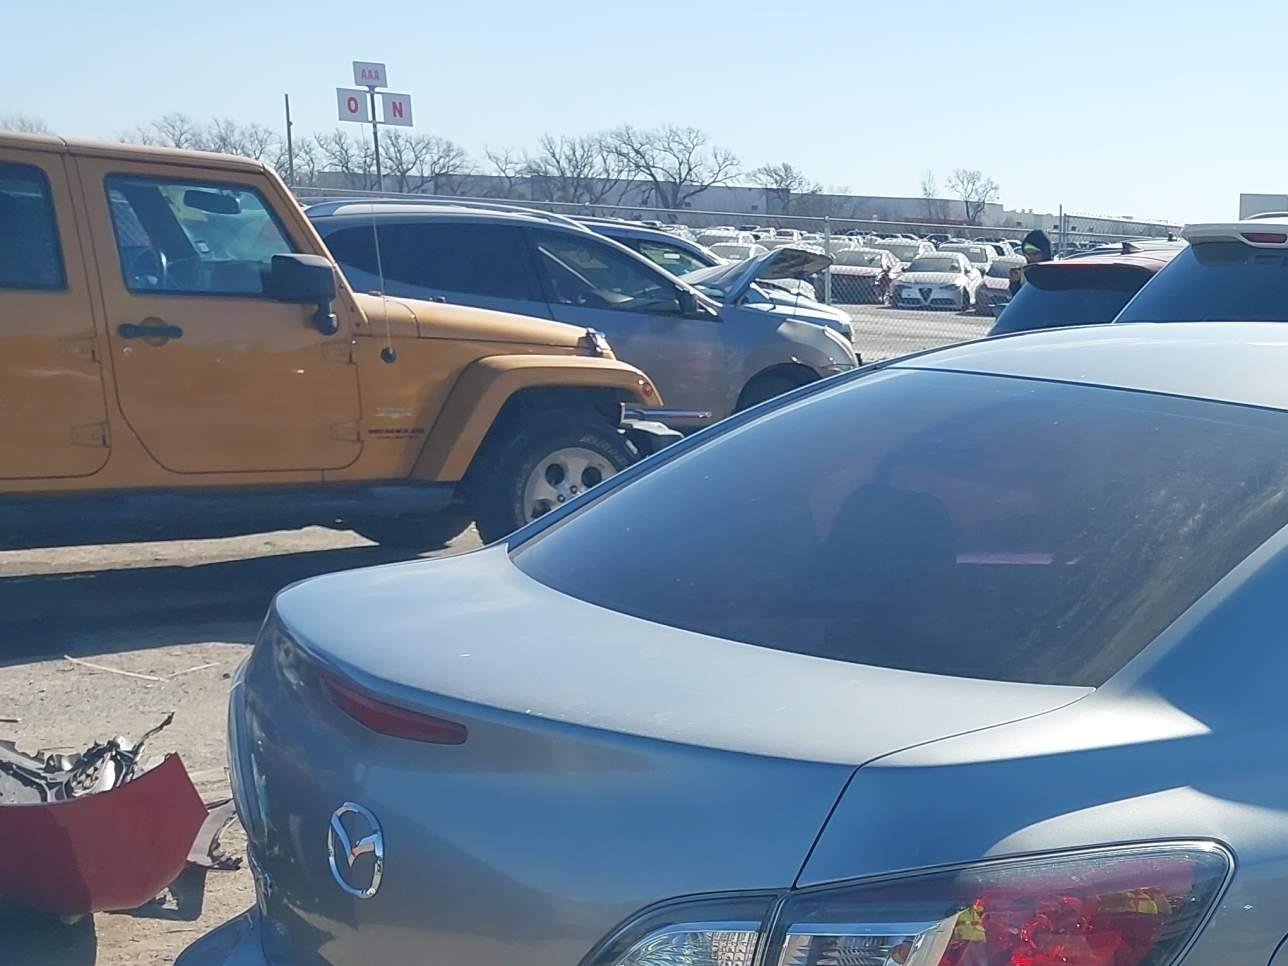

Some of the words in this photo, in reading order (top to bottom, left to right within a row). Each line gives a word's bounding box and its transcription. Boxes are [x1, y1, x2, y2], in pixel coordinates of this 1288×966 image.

[361, 69, 380, 81] AAA
[347, 96, 359, 113] O
[391, 101, 404, 118] N
